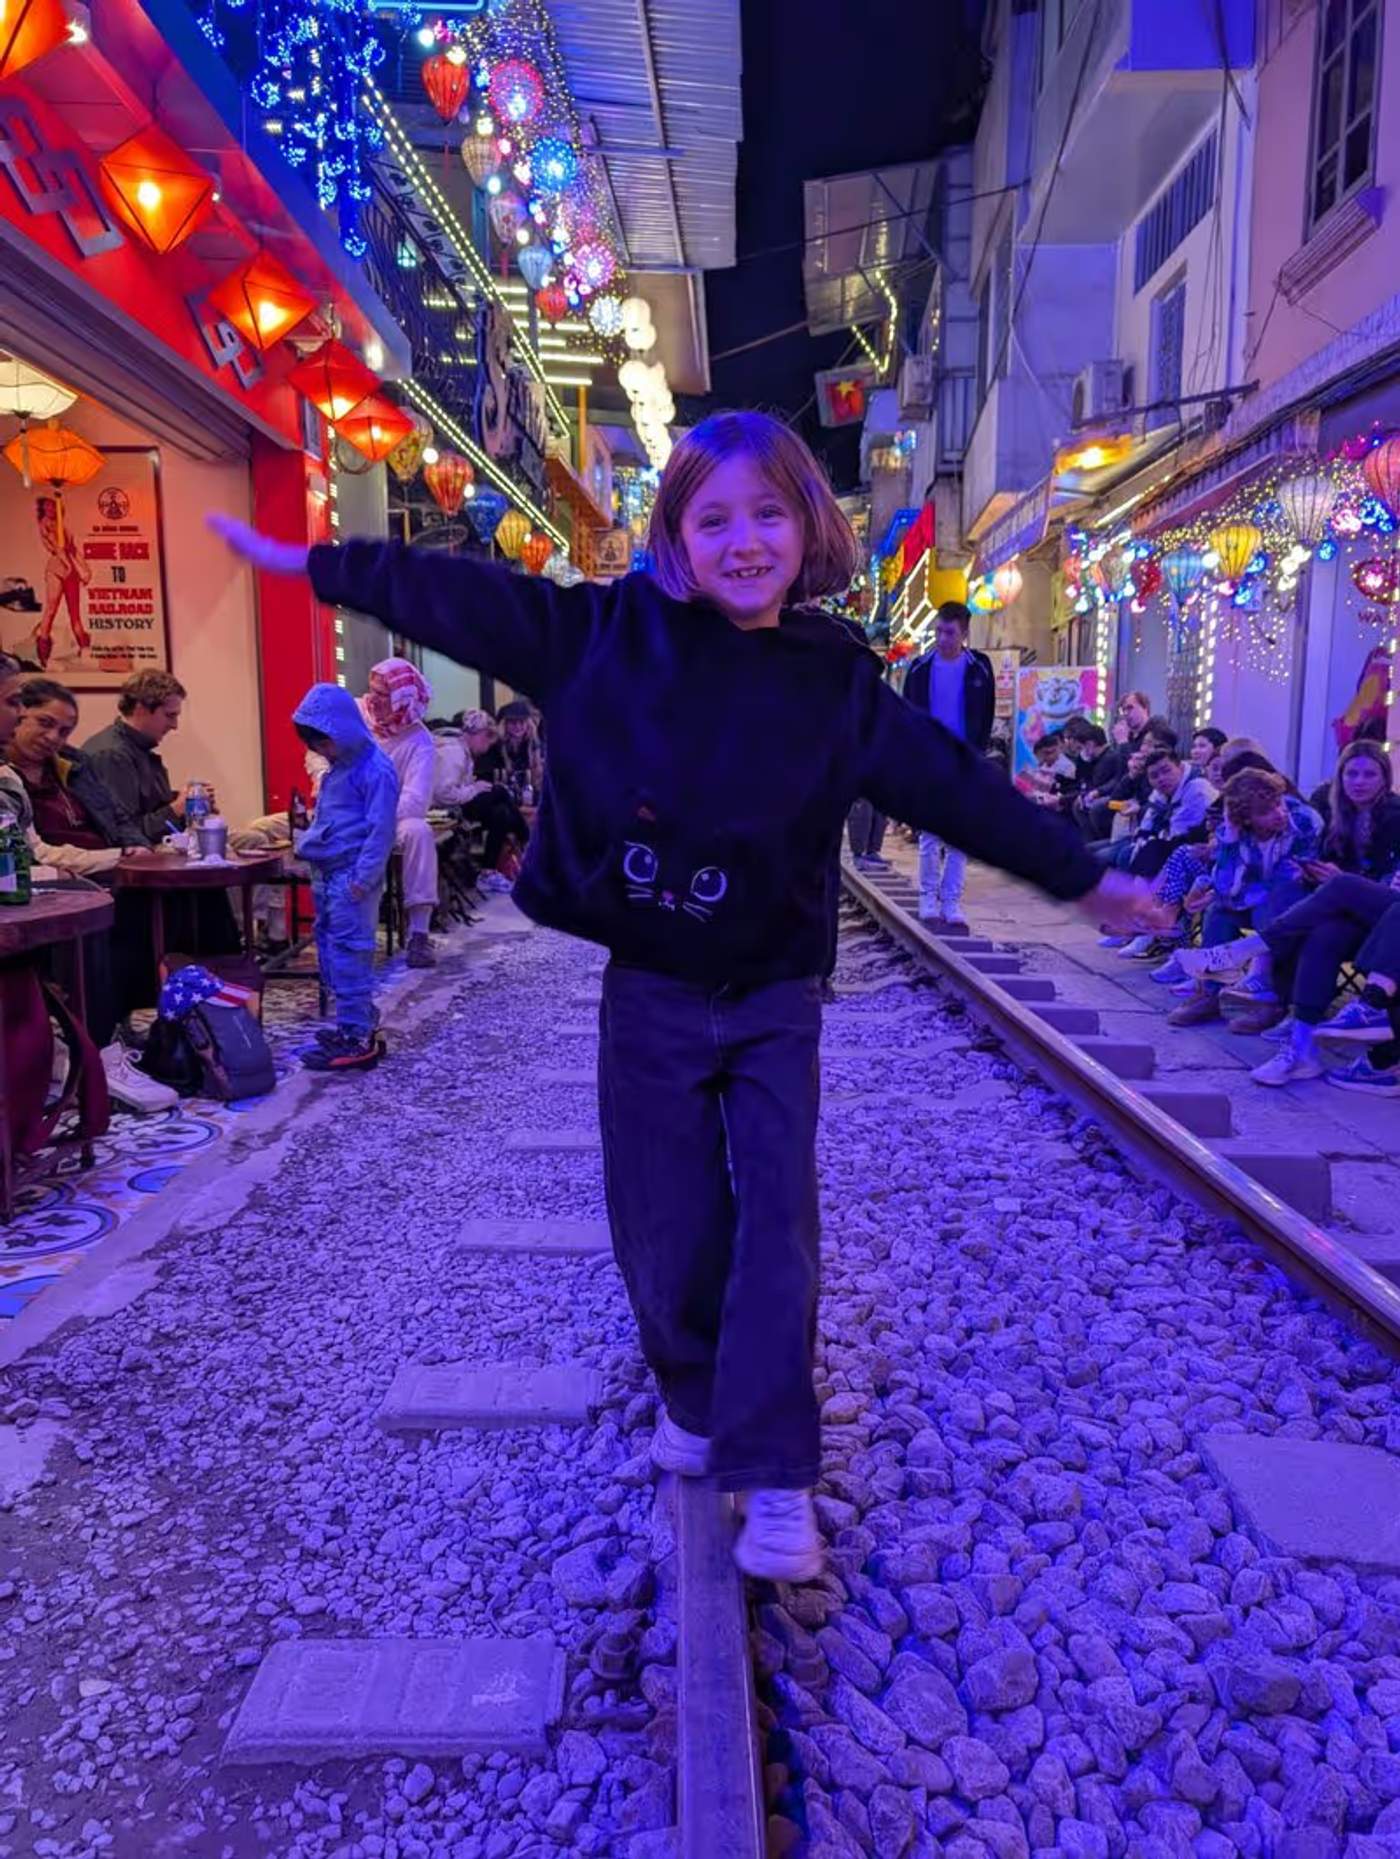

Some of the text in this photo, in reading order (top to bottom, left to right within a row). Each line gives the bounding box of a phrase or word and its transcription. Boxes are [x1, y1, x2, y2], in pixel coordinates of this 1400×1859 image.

[111, 565, 126, 583] TO
[87, 587, 153, 600] VIETNAM
[88, 603, 154, 615] RAILROAD
[88, 618, 156, 630] HISTORY
